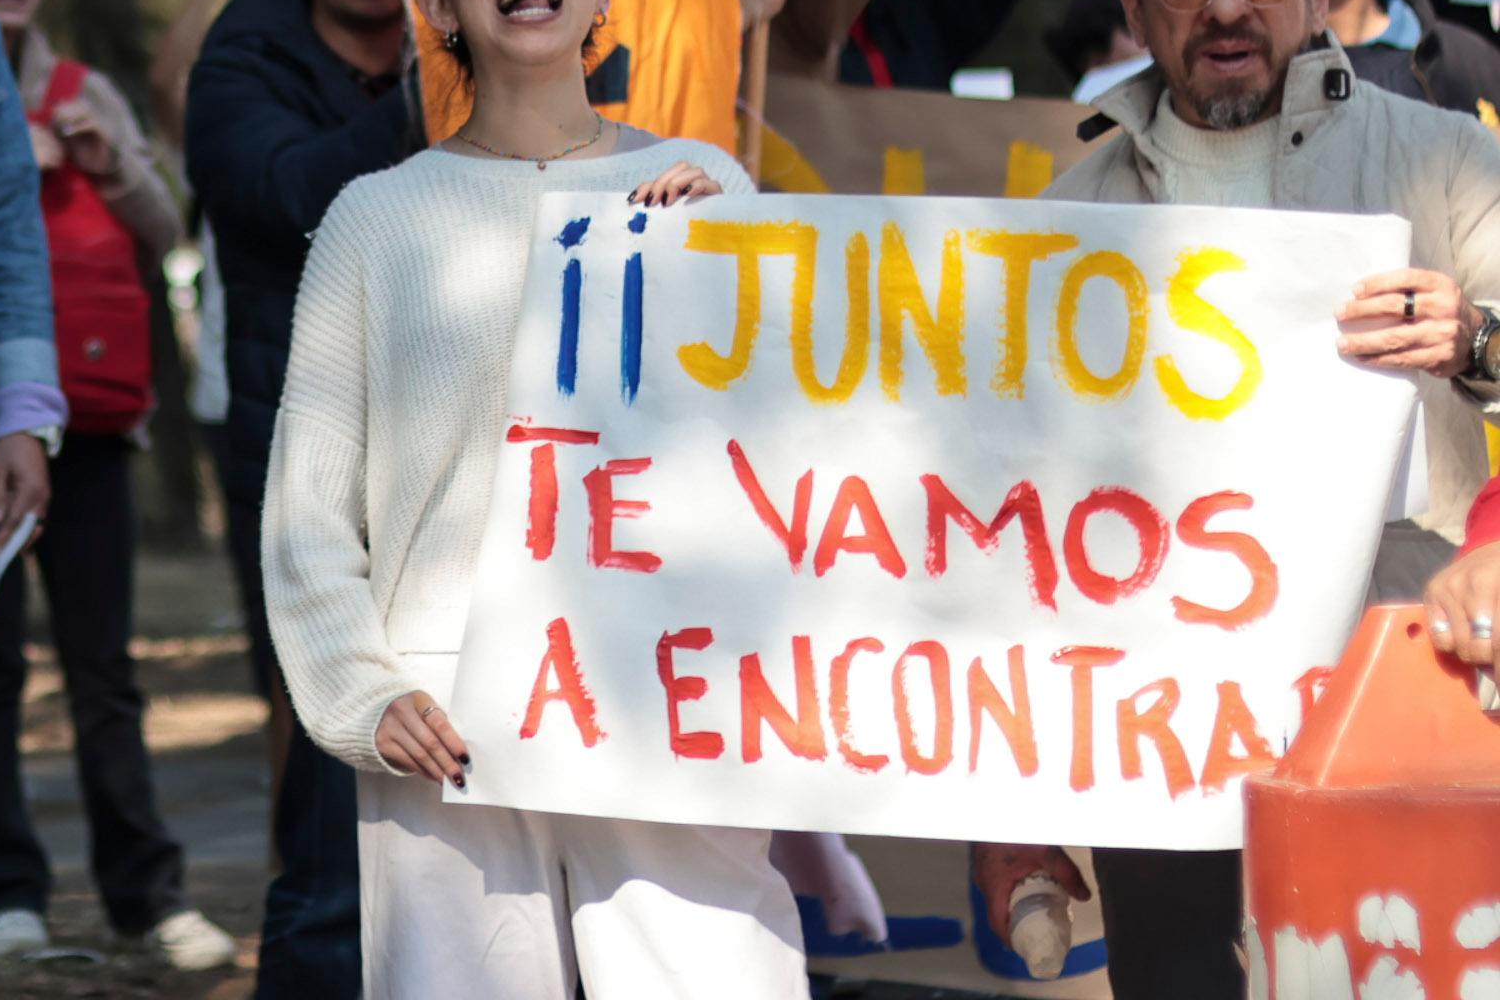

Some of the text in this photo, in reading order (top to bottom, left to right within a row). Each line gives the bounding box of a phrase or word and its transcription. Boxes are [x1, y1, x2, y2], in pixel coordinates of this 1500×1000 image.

[505, 413, 1280, 632] TE VAMOS
[510, 616, 1336, 802] A ENCONTRA
